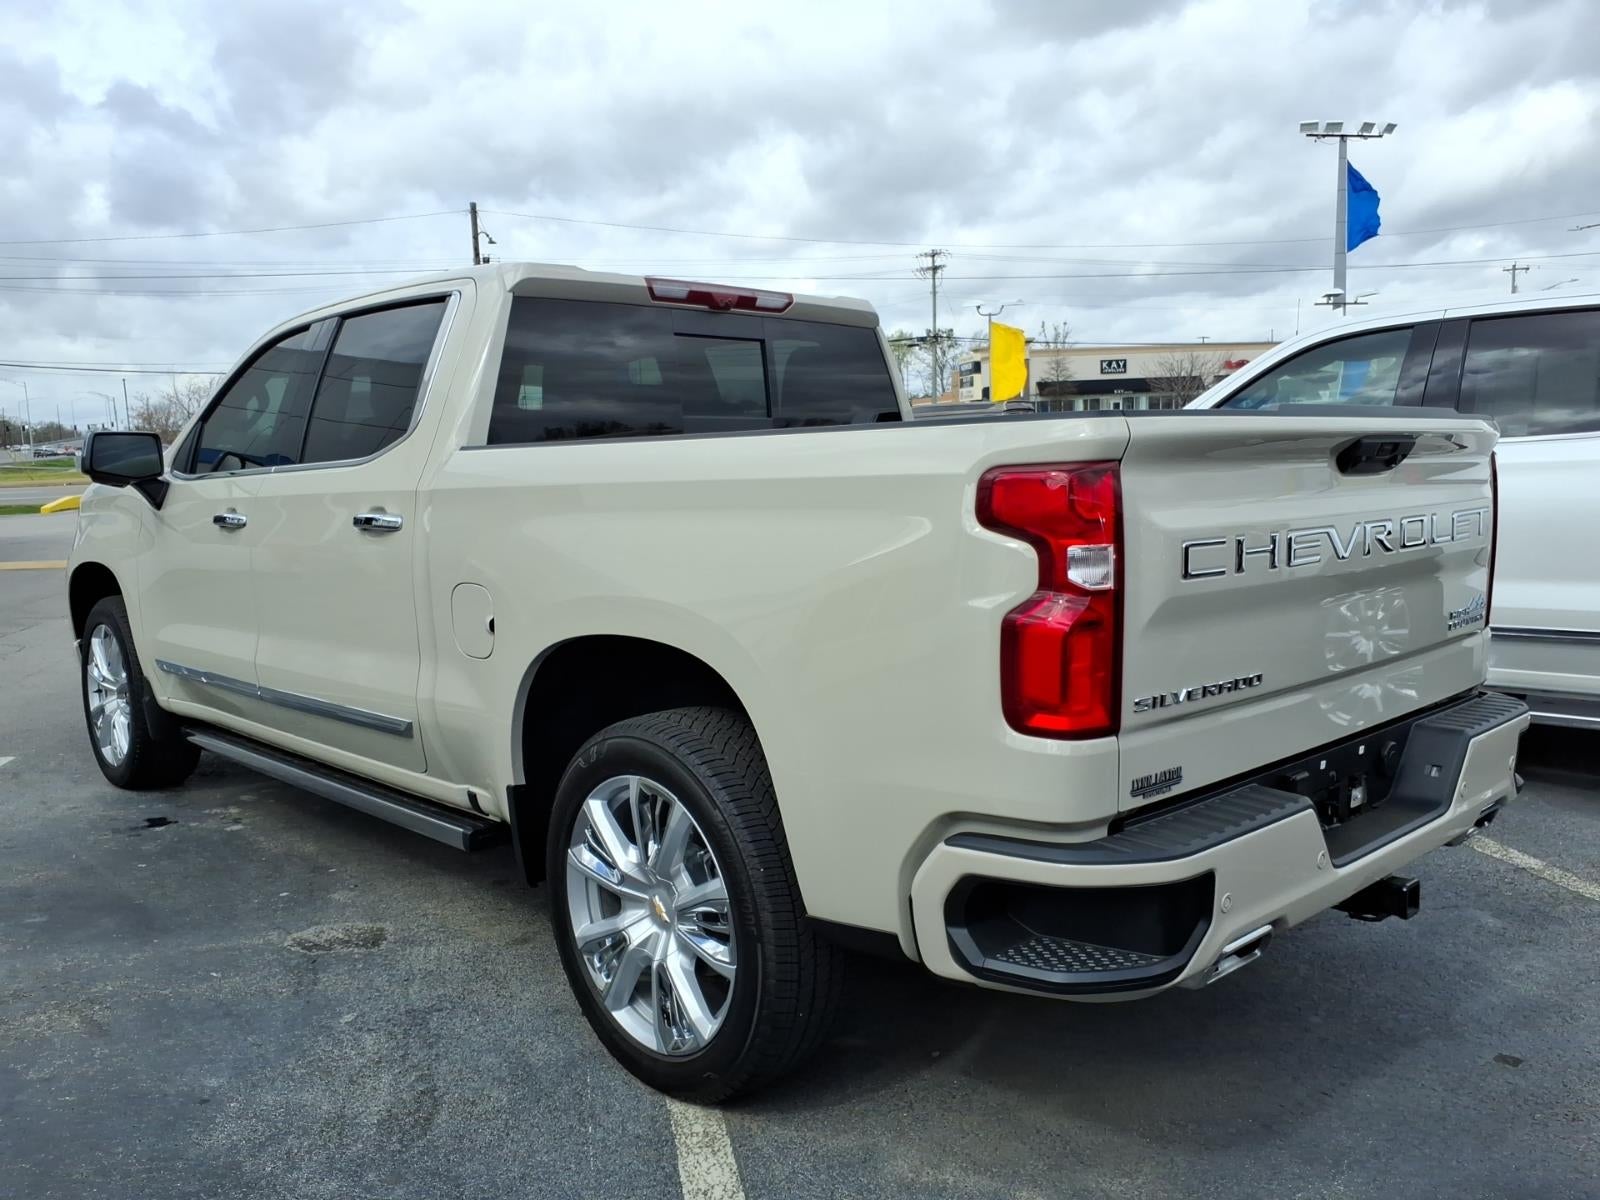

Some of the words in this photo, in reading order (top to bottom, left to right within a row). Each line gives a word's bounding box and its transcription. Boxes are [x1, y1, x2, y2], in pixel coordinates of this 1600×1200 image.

[1102, 361, 1125, 369] KAY
[1182, 508, 1489, 580] CHEVROLET
[1133, 672, 1263, 713] SILVERADO
